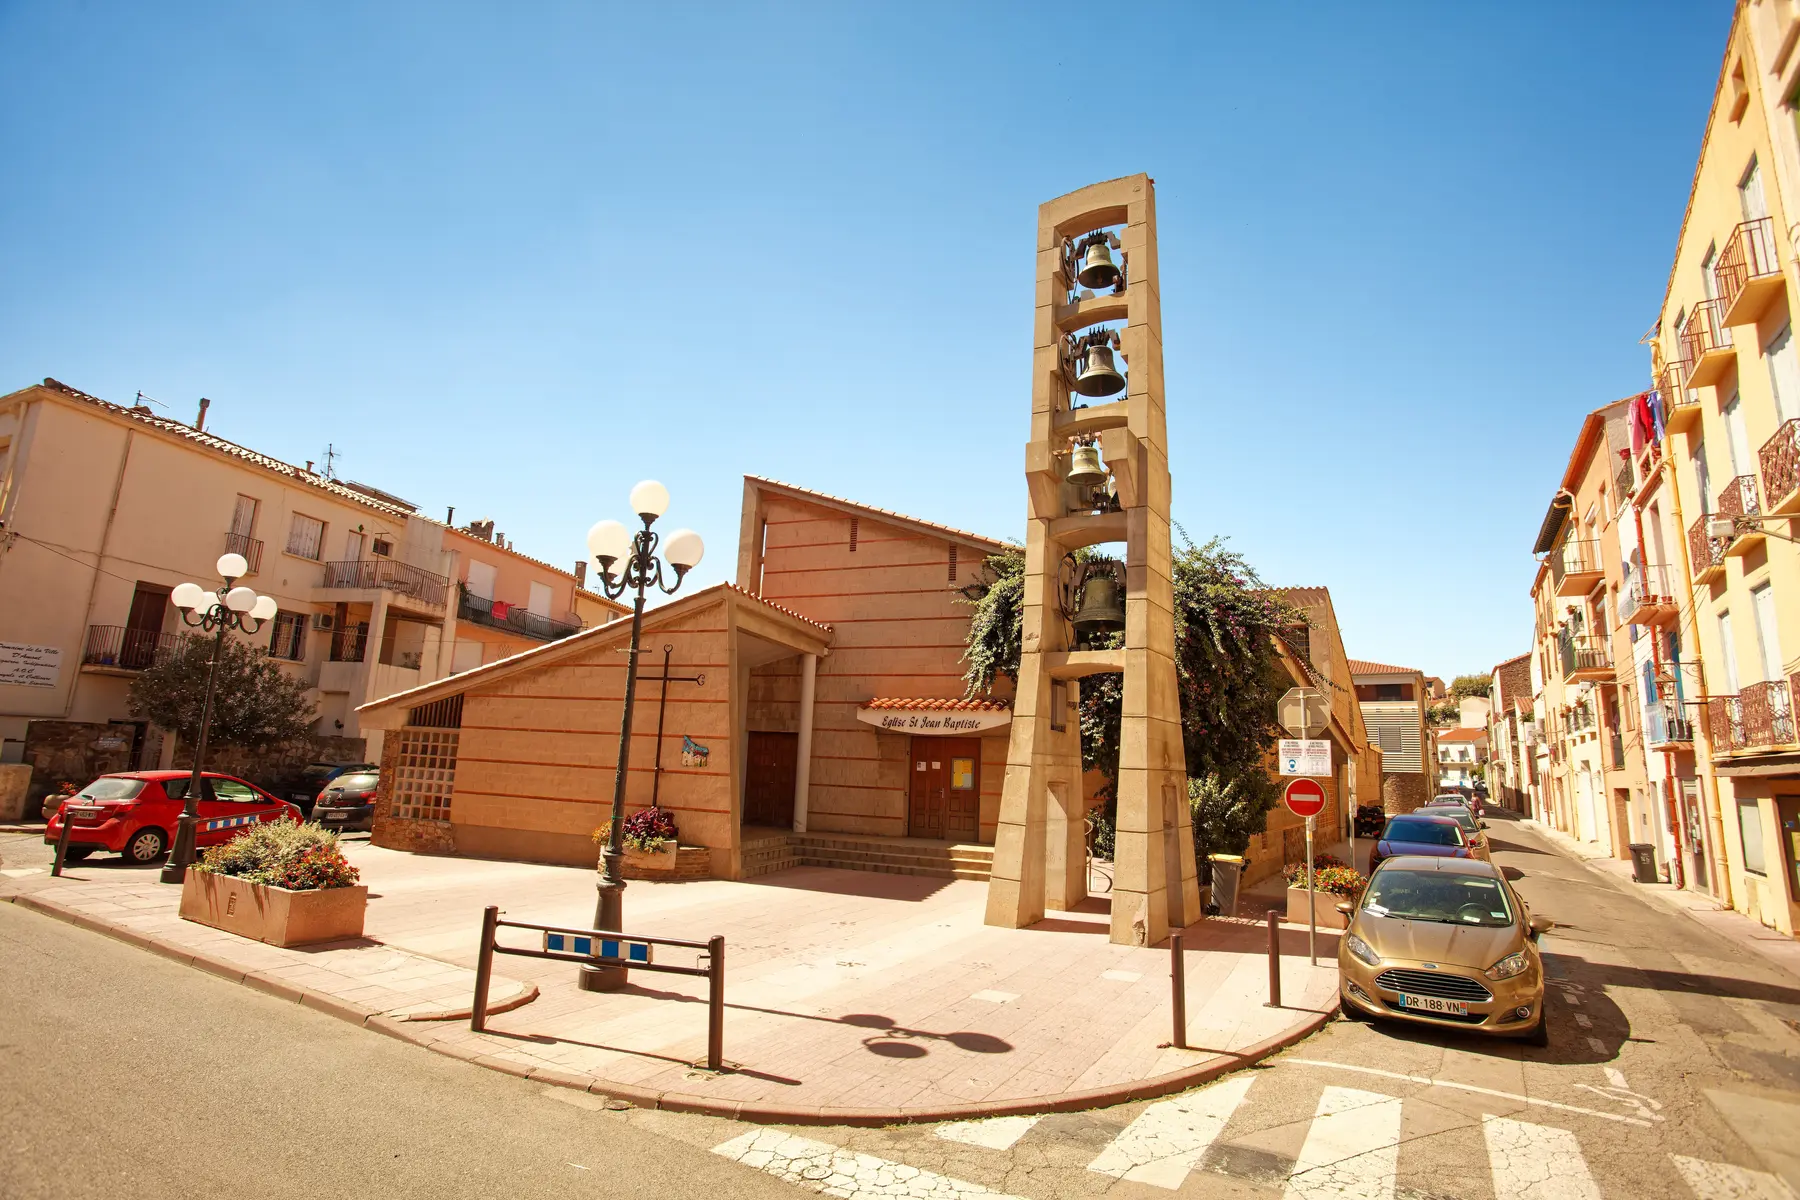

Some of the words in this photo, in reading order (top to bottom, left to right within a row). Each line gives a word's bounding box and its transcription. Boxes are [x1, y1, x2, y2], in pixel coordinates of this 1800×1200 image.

[881, 715, 907, 729] Eglise
[909, 716, 919, 728] St
[920, 716, 941, 729] Jean
[943, 717, 981, 731] Baptiste
